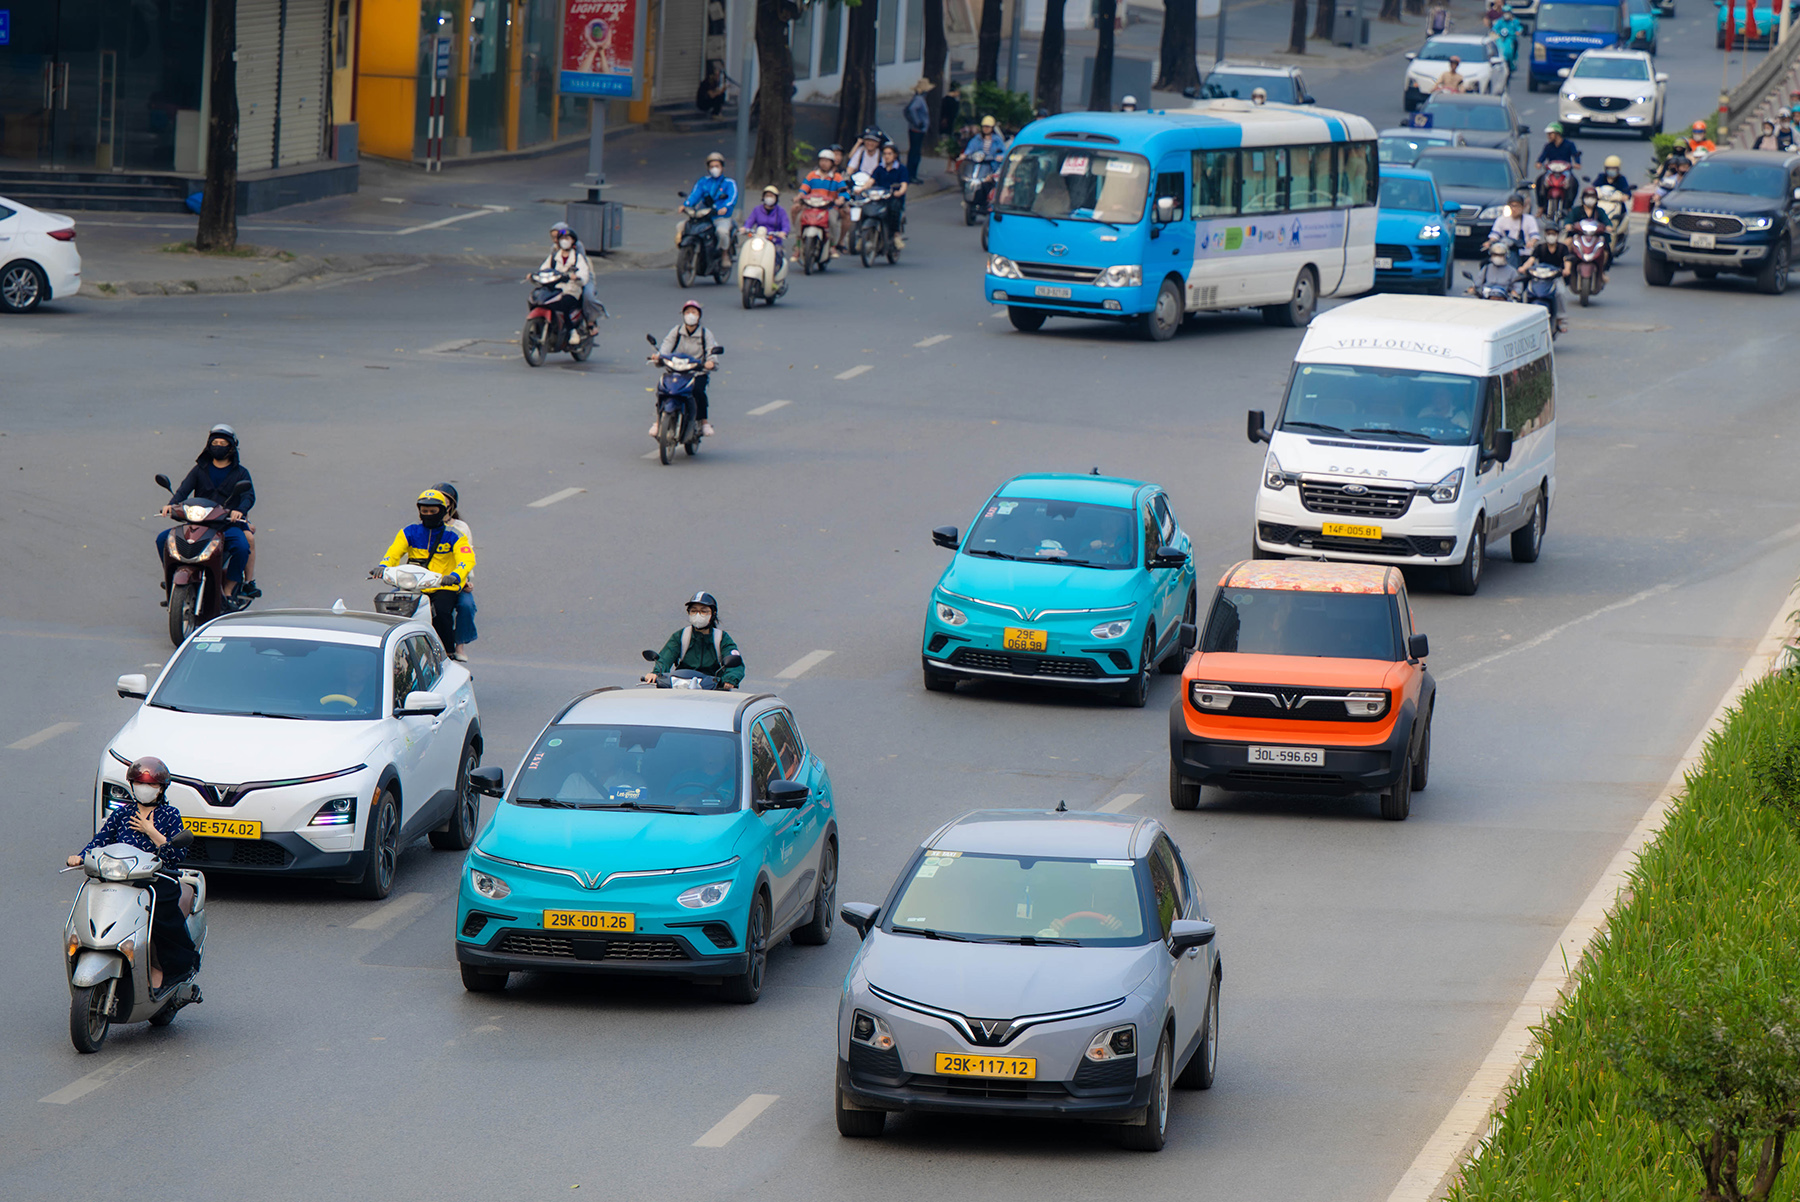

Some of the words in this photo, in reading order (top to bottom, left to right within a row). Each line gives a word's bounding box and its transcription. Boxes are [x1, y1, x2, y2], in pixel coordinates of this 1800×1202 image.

[570, 4, 601, 14] LIGHT
[602, 3, 627, 14] BOX
[1338, 339, 1367, 347] VIP
[1372, 339, 1452, 356] LOUNGE
[1328, 465, 1388, 477] DCAR
[1328, 525, 1377, 536] 14F-005.81
[1016, 629, 1035, 640] 29E
[1008, 638, 1042, 651] 068.98
[528, 752, 545, 769] TAXI
[1254, 748, 1318, 763] 30L-596.69
[184, 820, 254, 836] 29E-574.02
[551, 914, 627, 929] 29K-001.26
[944, 1057, 1028, 1075] 29K-117.12
